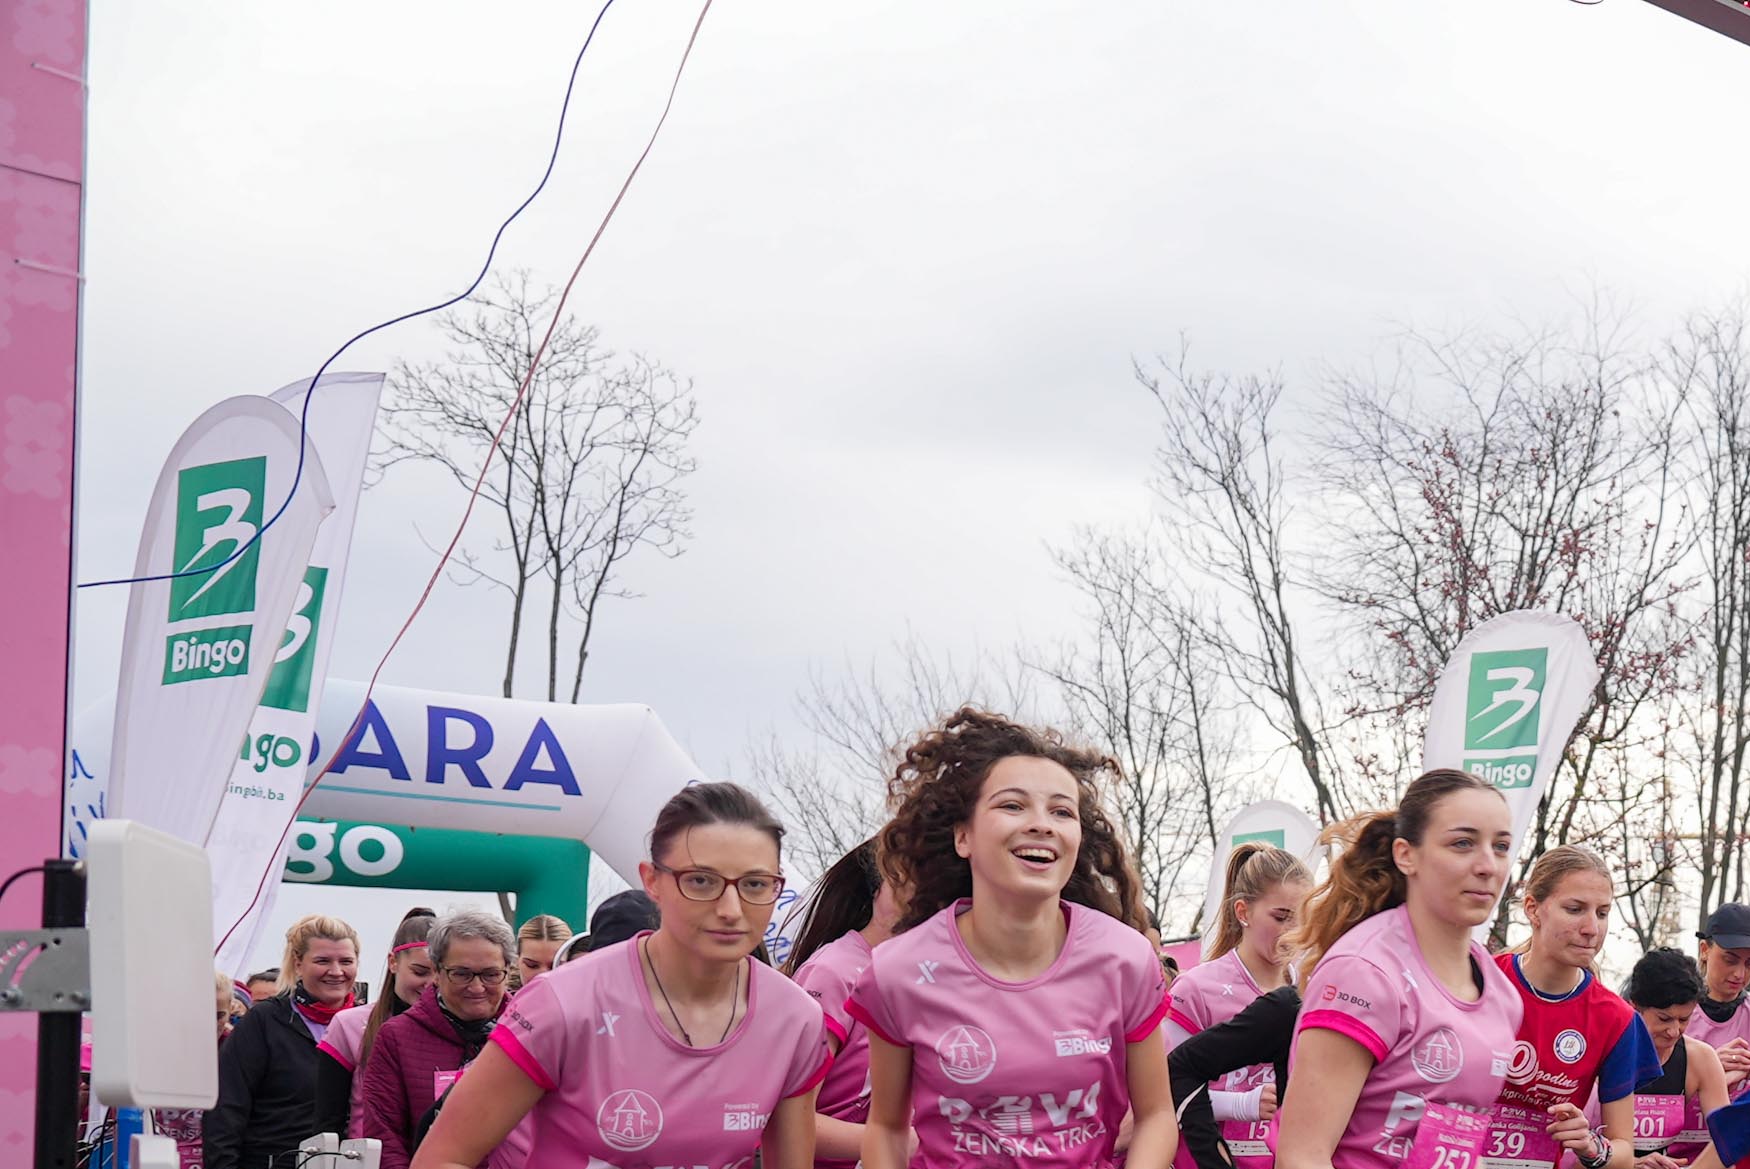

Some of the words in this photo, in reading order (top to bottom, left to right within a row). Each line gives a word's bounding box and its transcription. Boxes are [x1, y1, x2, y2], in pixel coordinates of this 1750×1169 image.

[171, 636, 246, 674] Bingo
[240, 733, 302, 773] go
[308, 698, 583, 796] ARA
[282, 820, 404, 882] go
[1350, 996, 1371, 1009] BOX
[951, 1126, 1053, 1158] ŽENSKA
[1053, 1121, 1107, 1152] TRKA
[1487, 1131, 1526, 1158] 39
